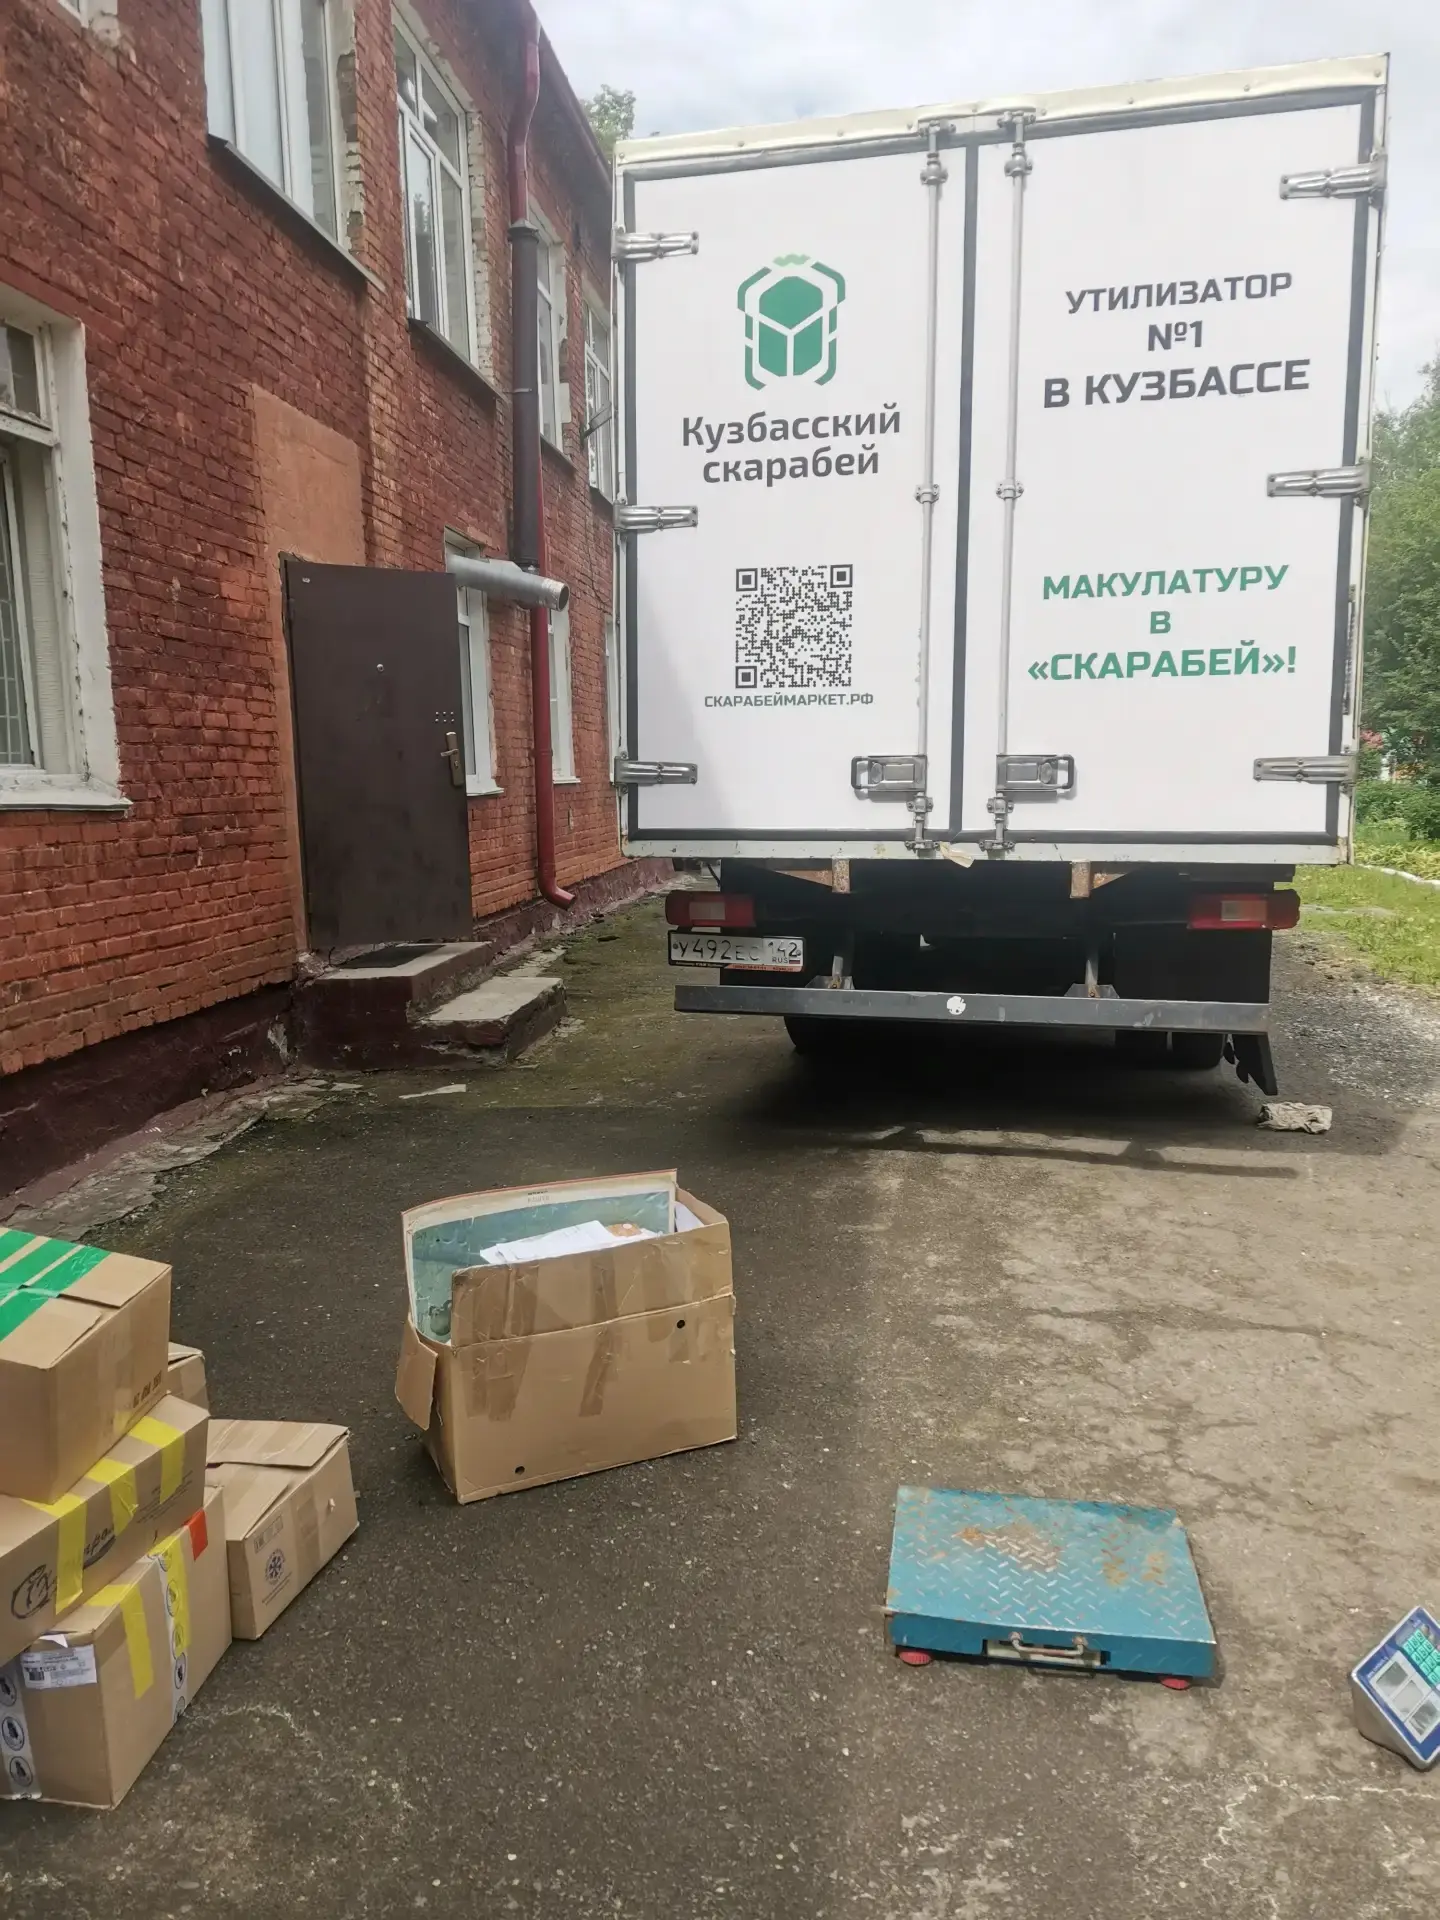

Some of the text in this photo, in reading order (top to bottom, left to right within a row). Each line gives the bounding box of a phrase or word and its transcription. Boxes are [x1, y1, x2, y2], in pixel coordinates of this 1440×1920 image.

[1065, 272, 1293, 315] УТИЛИЗАТОР
[1147, 320, 1203, 352] №1
[1043, 358, 1311, 409] В КУЗБАССЕ
[682, 402, 901, 455] Кузбасский
[702, 445, 880, 488] скарабей
[1043, 564, 1289, 600] МАКУЛАТУРУ
[1149, 610, 1172, 635] В
[1027, 639, 1297, 681] «СКАРАБЕЙ»!
[704, 693, 874, 708] СКАРАБЕЙМАРКЕТ.РФ
[771, 956, 789, 964] RUS
